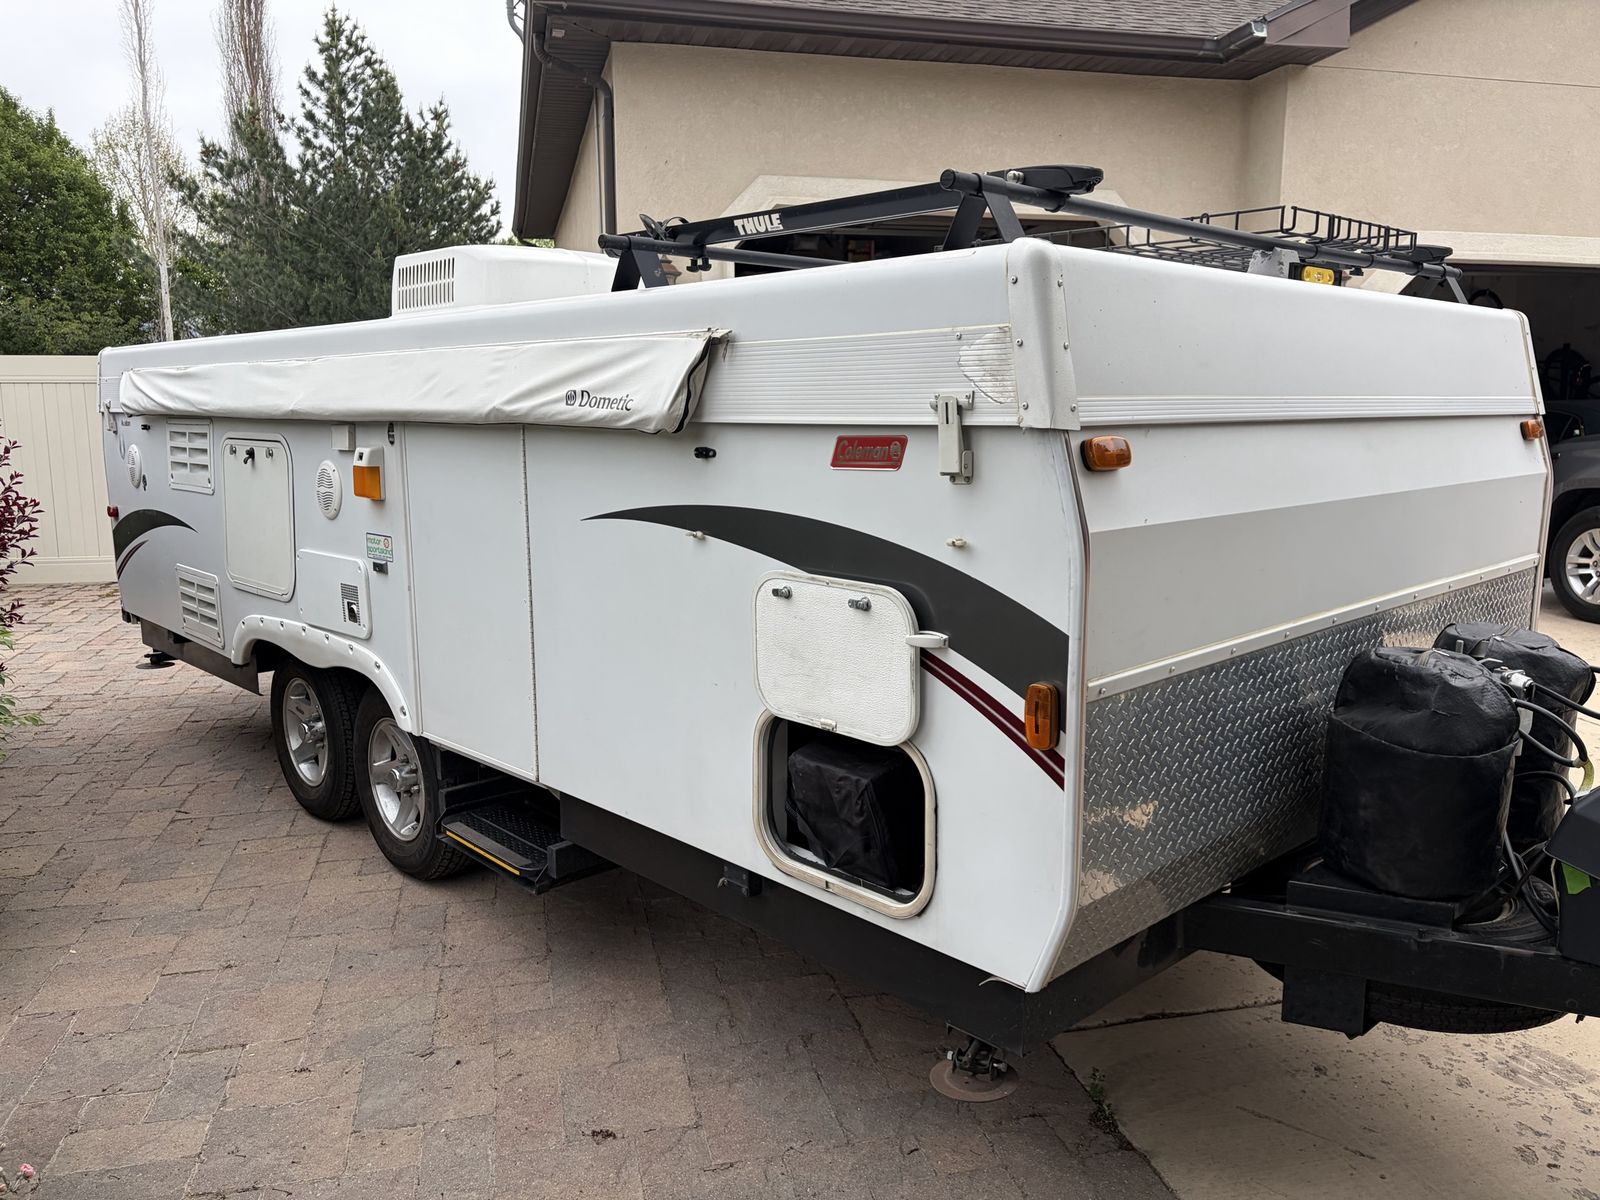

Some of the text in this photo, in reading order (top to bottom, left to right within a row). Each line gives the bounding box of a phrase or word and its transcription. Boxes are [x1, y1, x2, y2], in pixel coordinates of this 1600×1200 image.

[733, 213, 784, 236] THULE
[578, 390, 634, 411] Dometic
[837, 440, 889, 461] Coleman
